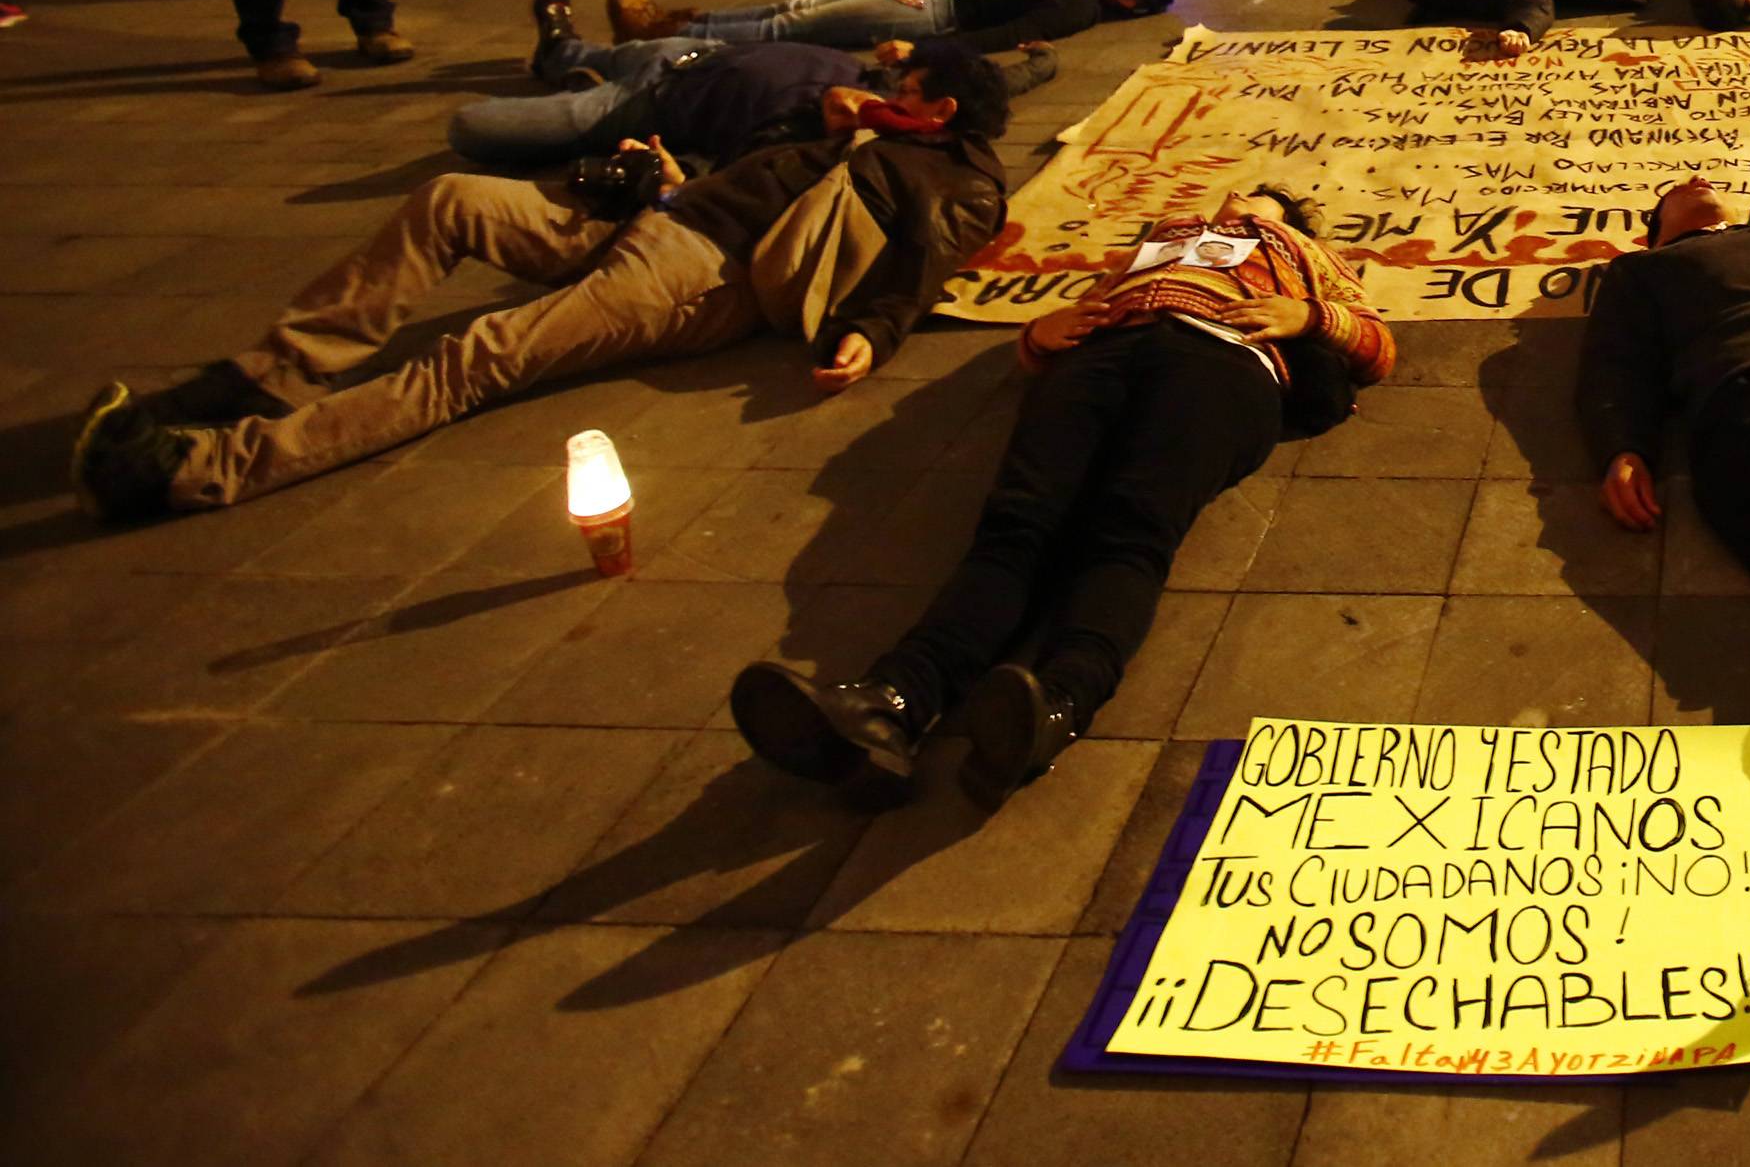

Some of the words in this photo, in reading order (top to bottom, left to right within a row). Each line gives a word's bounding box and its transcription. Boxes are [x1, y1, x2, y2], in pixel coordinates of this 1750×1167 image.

[1452, 206, 1517, 255] YA
[1421, 268, 1511, 309] DE
[1241, 723, 1456, 791] GOBIERNO
[1504, 727, 1682, 795] ESTADO
[1219, 791, 1726, 852] MEXICANOS
[1256, 914, 1334, 965] NO
[1340, 904, 1590, 971] SOMOS
